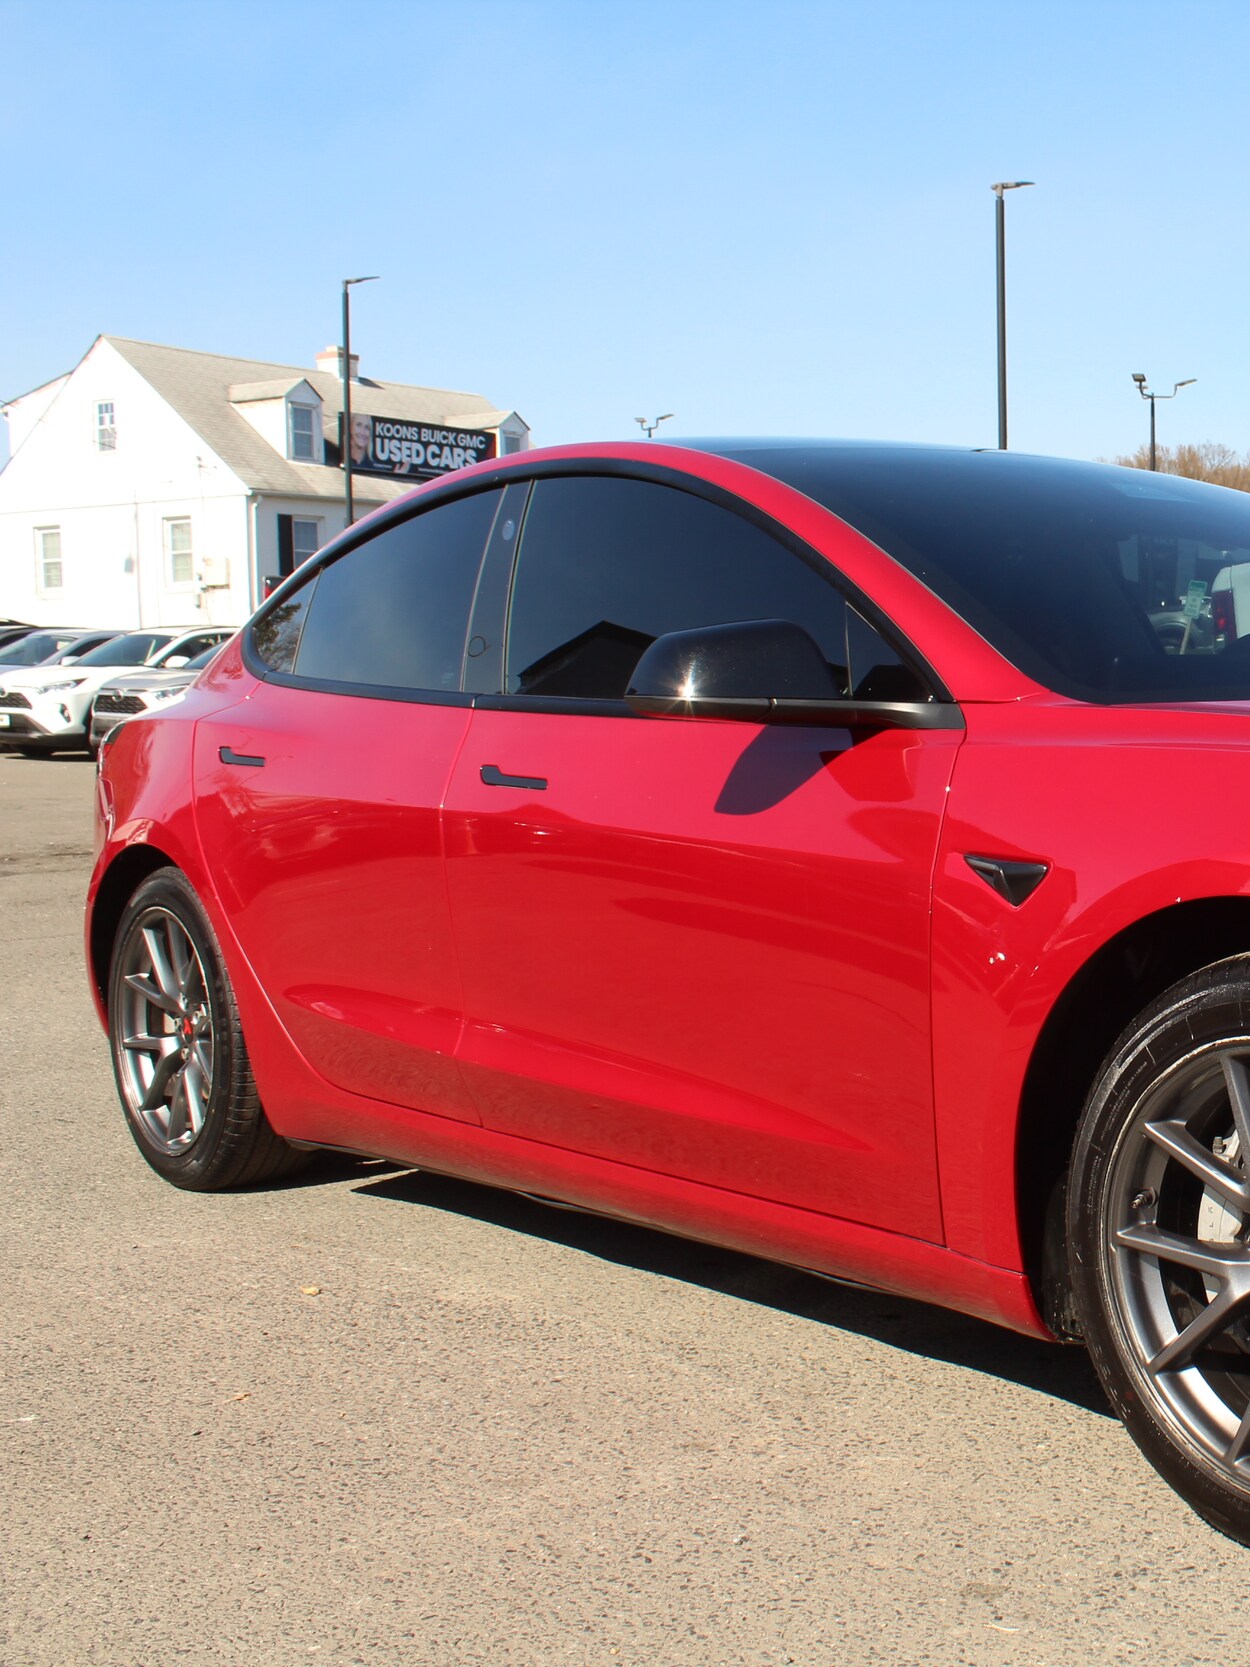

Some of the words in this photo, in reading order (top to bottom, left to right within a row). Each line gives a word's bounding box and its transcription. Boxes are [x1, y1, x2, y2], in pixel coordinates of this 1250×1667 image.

[375, 421, 419, 440] KOONS
[420, 428, 457, 446] BUICK
[457, 433, 486, 449] GMC
[375, 438, 425, 465] USED
[426, 444, 478, 469] CARS
